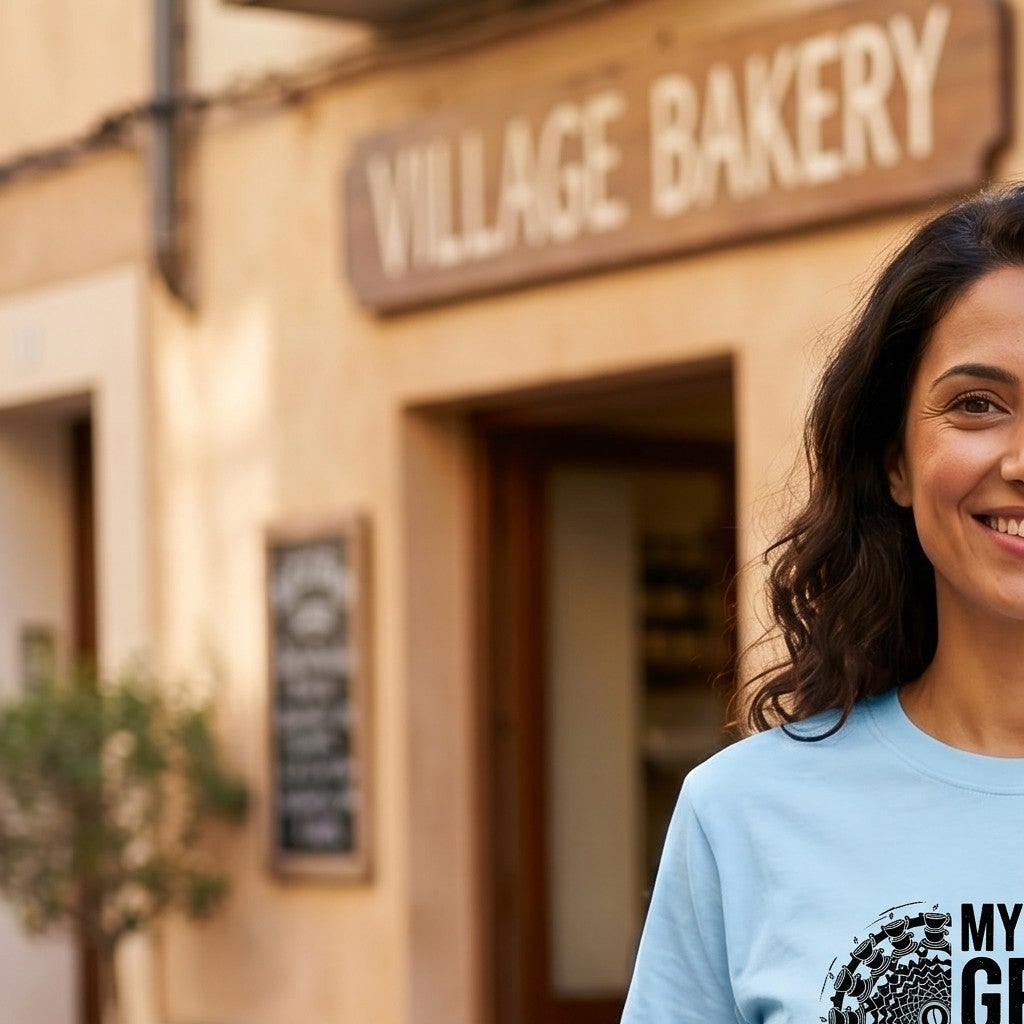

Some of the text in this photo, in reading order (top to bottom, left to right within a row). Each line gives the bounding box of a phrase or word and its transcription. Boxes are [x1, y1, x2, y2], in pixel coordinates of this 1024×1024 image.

[366, 4, 951, 279] VILLAGE BAKERY
[960, 903, 1024, 952] MY
